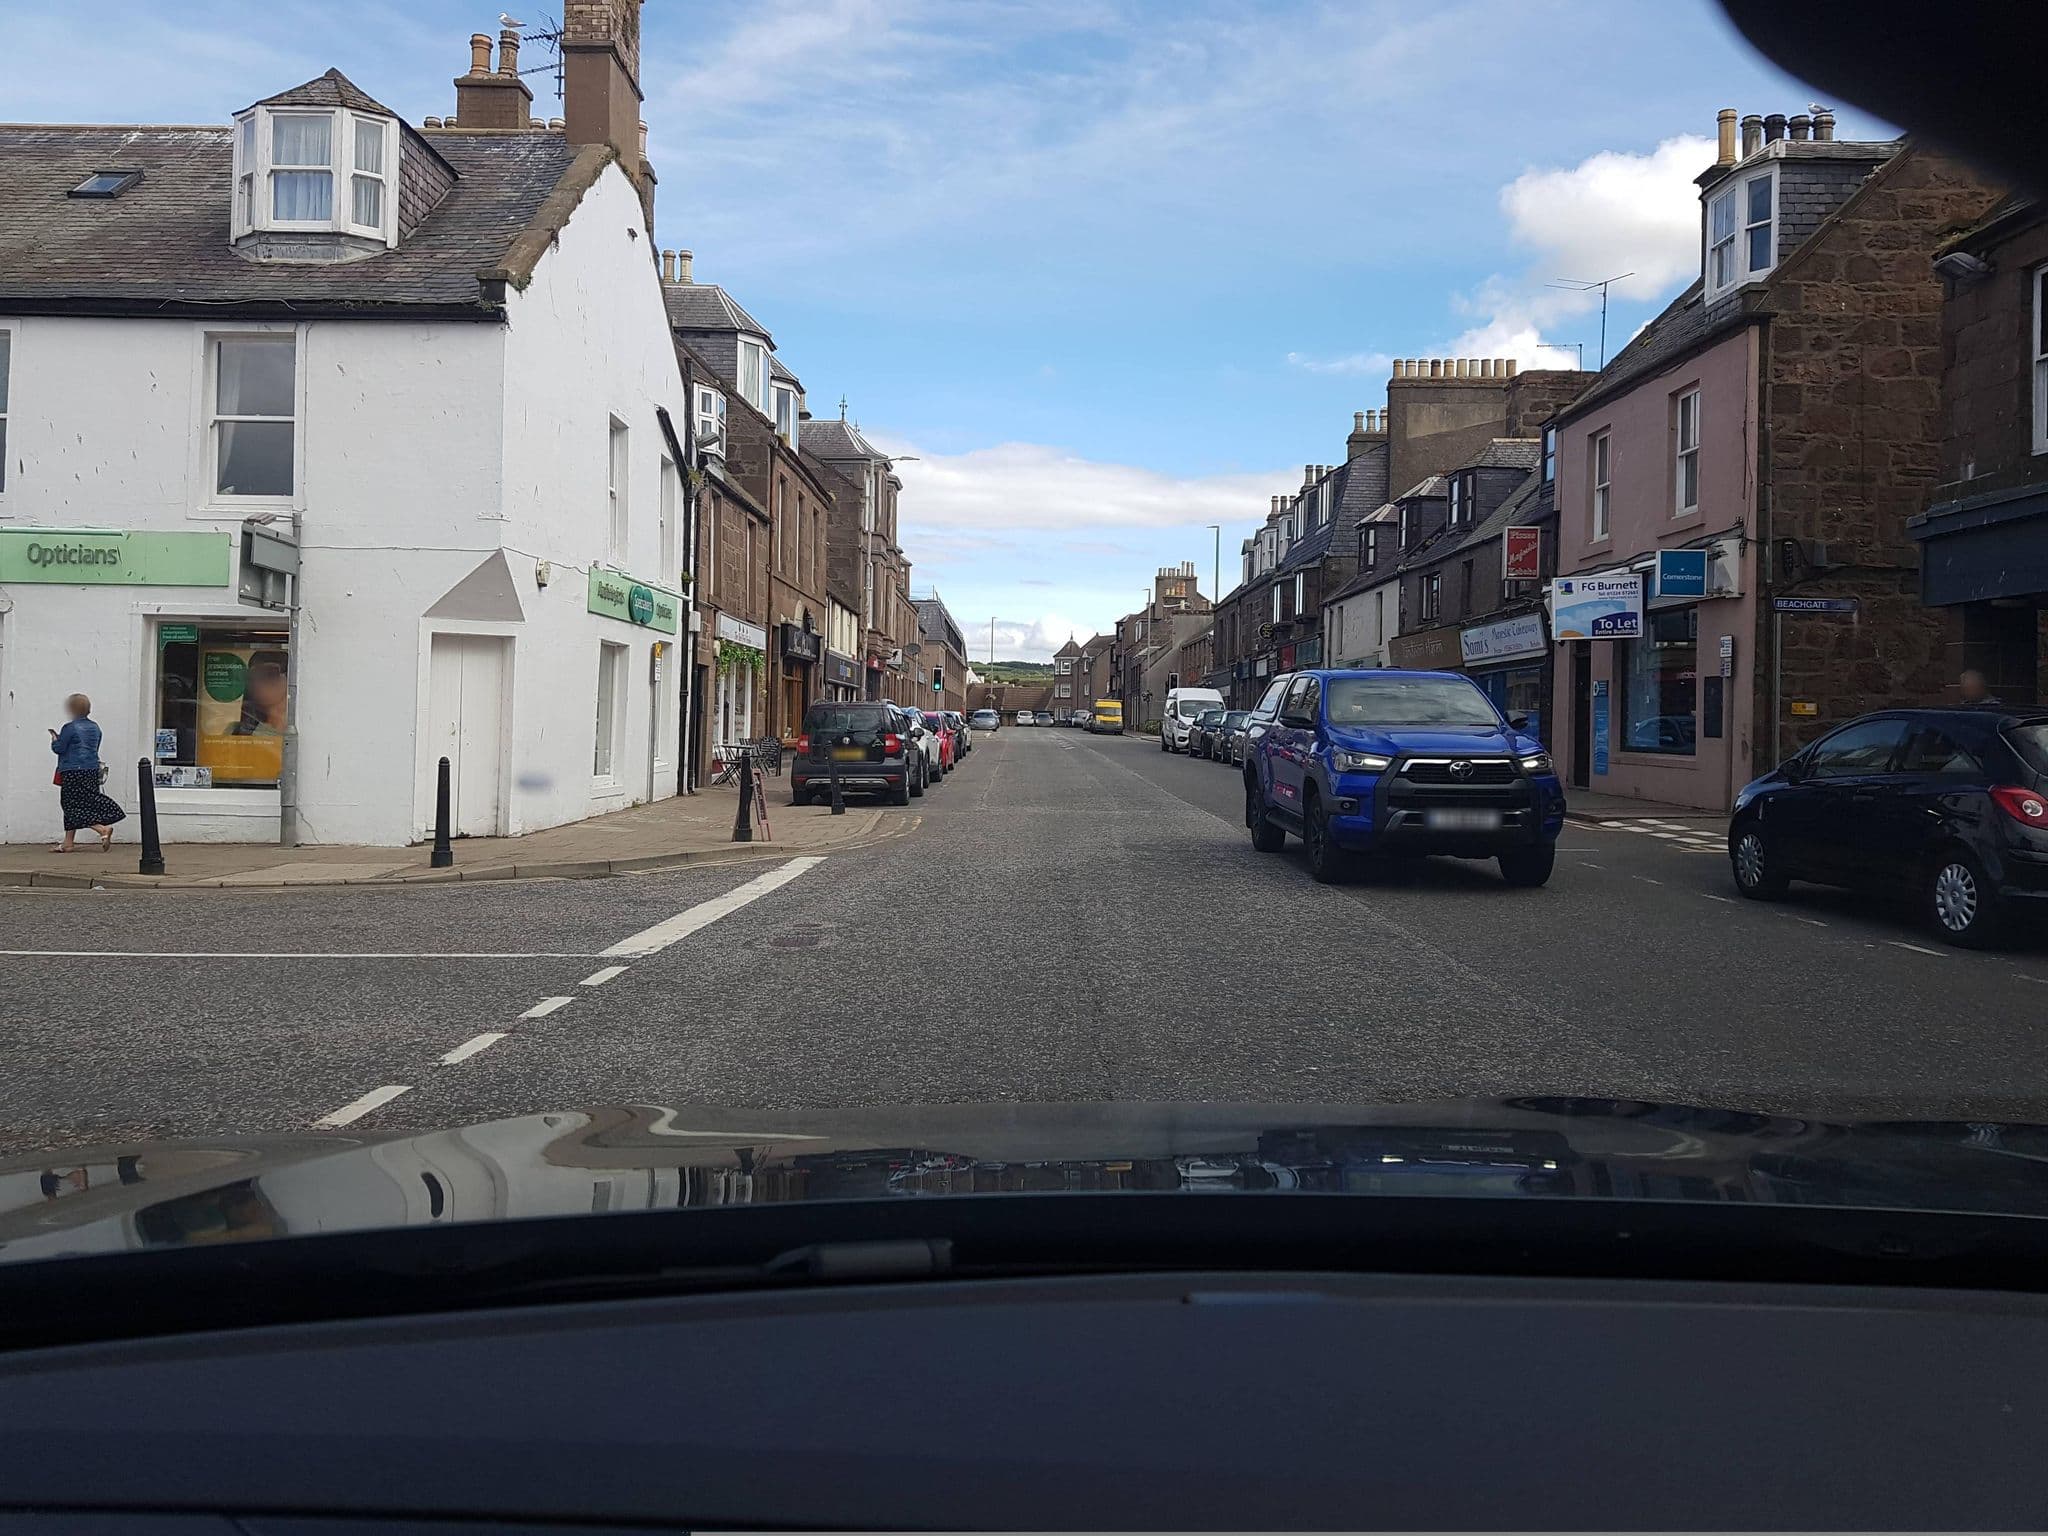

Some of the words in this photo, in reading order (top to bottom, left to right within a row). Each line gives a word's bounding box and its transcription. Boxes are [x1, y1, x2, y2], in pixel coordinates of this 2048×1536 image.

[27, 543, 118, 568] Opticians
[1662, 573, 1703, 581] Cornerstone
[1581, 582, 1596, 591] FG
[1598, 580, 1638, 590] Burnett
[1777, 600, 1826, 608] BEACHGATE
[1599, 619, 1614, 629] To
[1617, 618, 1637, 628] Let
